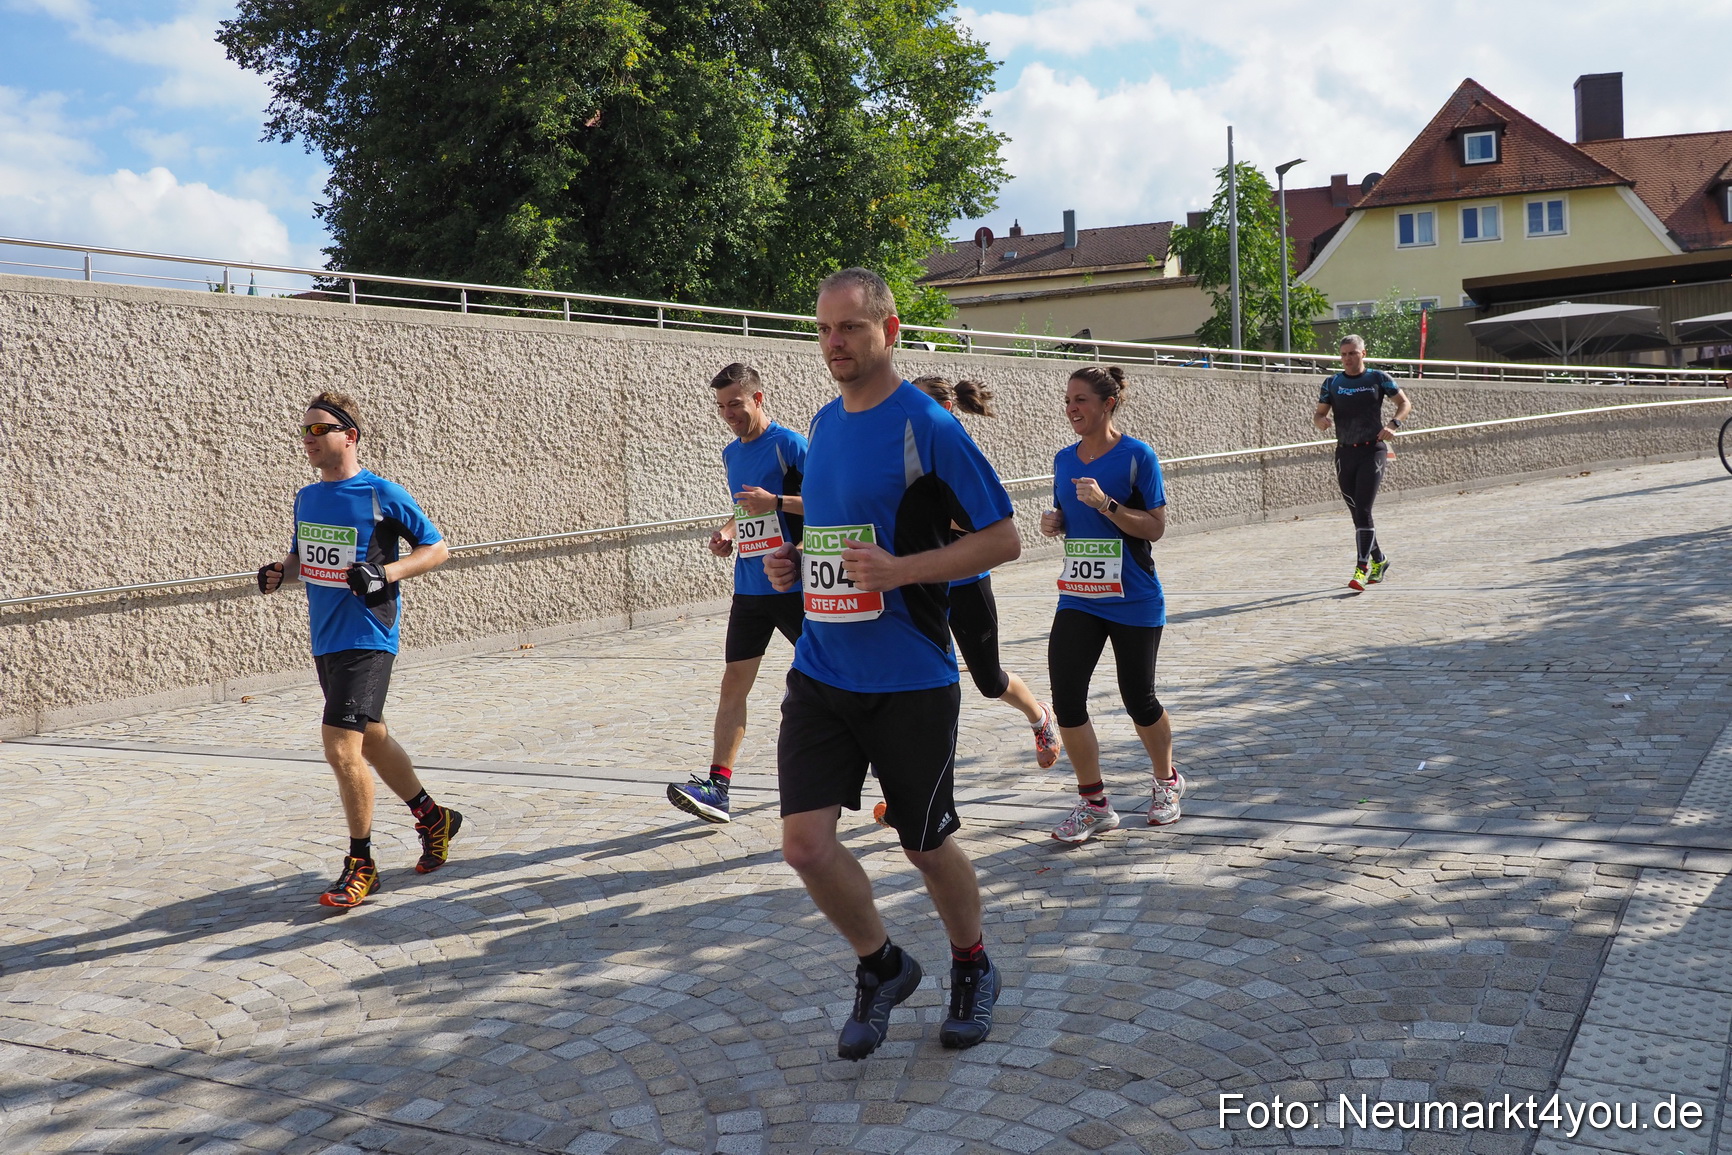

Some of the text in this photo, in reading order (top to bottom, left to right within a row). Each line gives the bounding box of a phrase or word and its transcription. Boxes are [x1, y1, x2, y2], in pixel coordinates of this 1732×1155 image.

[301, 525, 349, 542] BOCK
[738, 520, 765, 539] 507
[741, 541, 769, 552] FRANK
[1067, 542, 1115, 555] BOCK
[306, 545, 340, 566] 506
[304, 567, 346, 580] WOLFGANG
[1070, 561, 1105, 579] 505
[1065, 583, 1112, 592] SUSANNE
[812, 598, 858, 611] STEFAN
